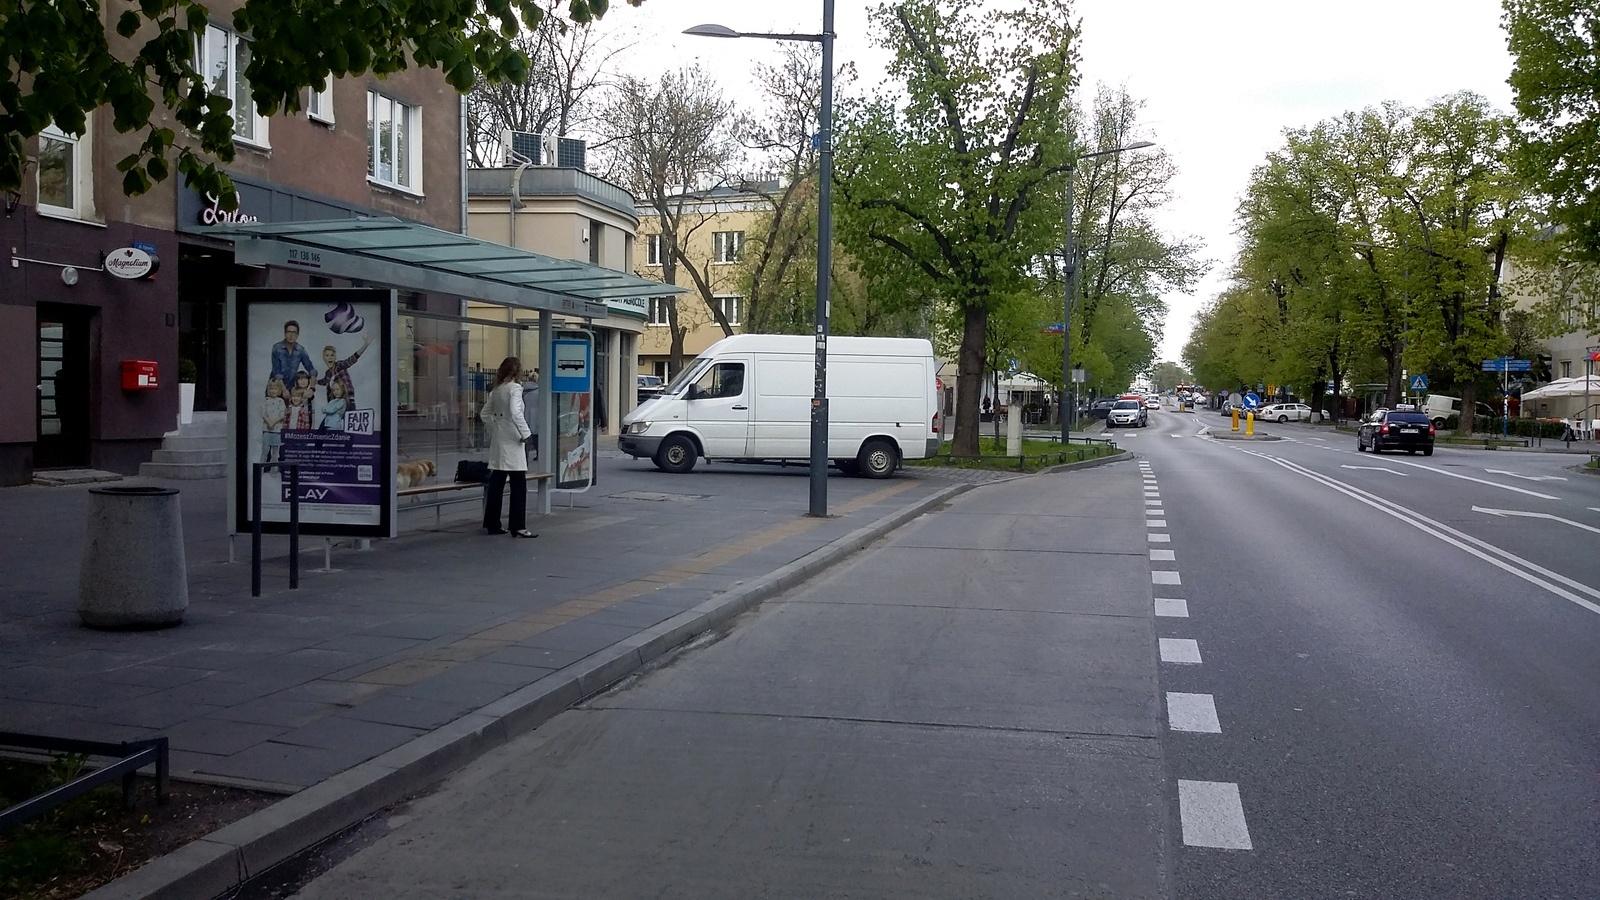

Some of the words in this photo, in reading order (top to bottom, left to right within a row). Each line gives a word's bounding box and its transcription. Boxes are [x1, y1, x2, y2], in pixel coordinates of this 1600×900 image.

[108, 258, 149, 269] Magnolium
[347, 412, 370, 423] FAIR
[347, 422, 370, 433] PLAY
